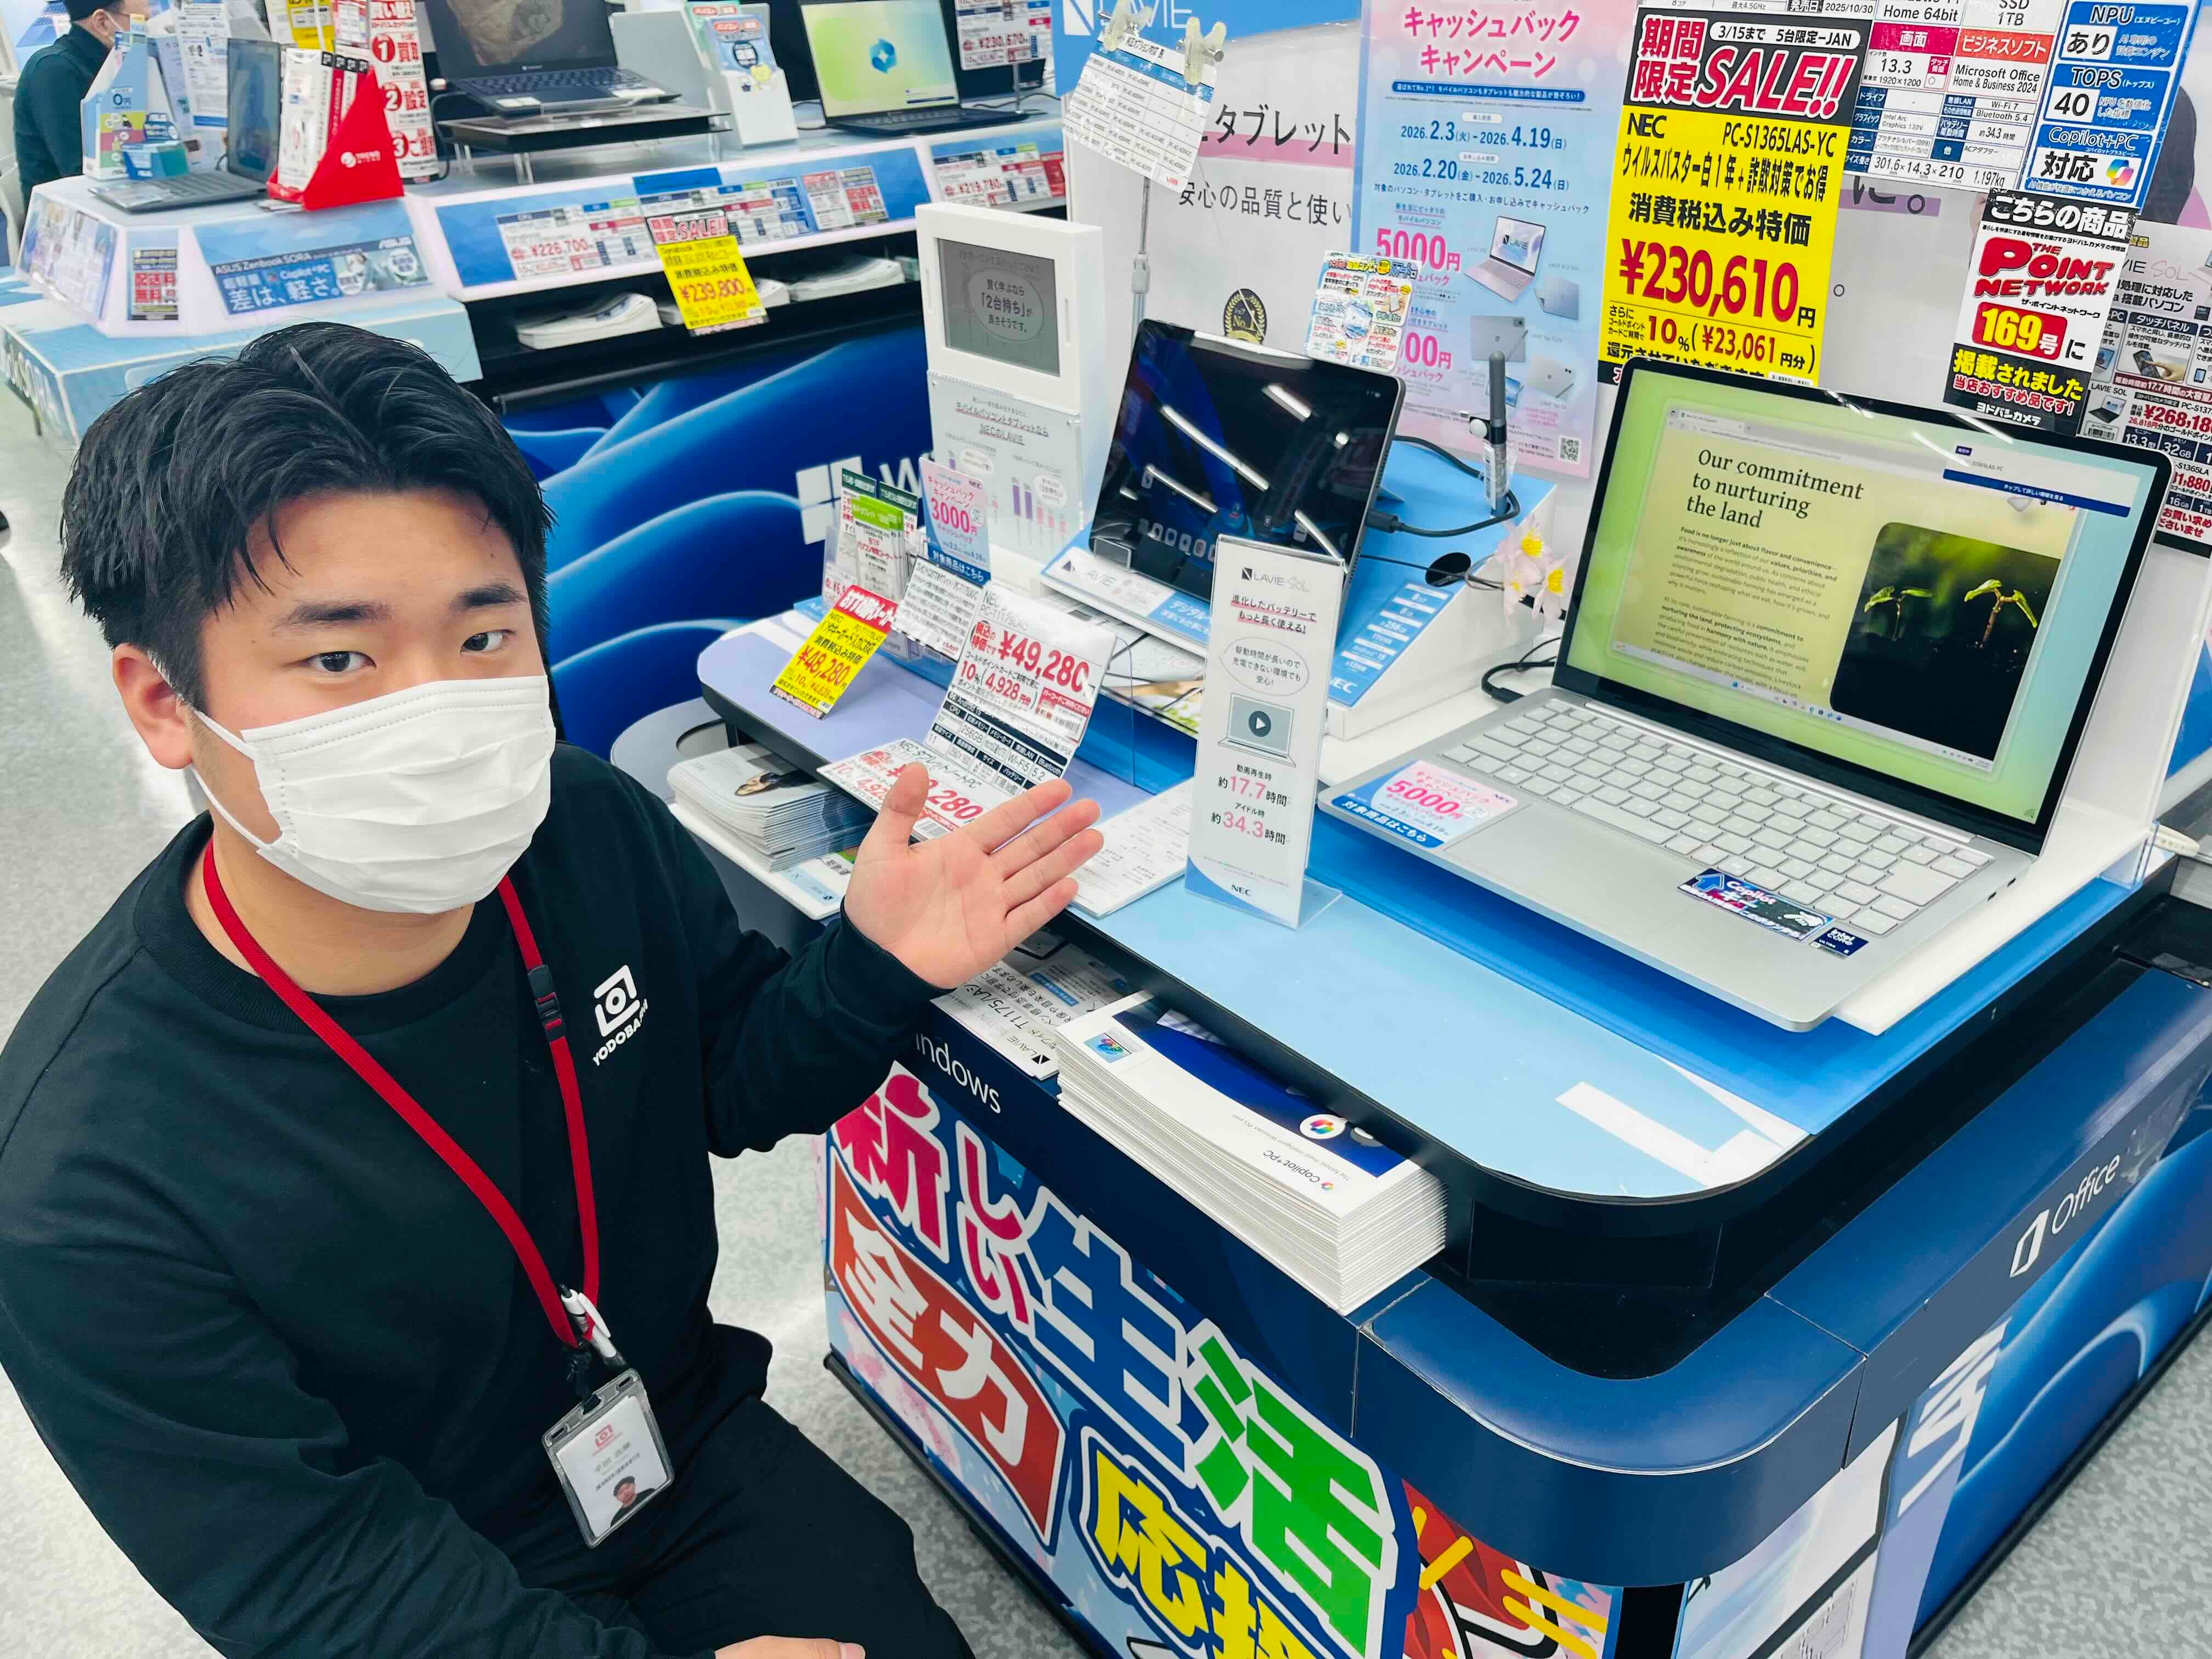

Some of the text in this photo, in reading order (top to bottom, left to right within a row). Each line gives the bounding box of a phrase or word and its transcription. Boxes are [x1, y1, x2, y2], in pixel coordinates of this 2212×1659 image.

[1825, 3, 1874, 14] 2025/10/30
[1883, 4, 1958, 22] Home 64bit
[1998, 12, 2024, 26] 1TB
[2090, 5, 2134, 24] NPU
[1404, 6, 1580, 42] キャッシュバック
[1718, 25, 1766, 41] 3/15まで
[1640, 16, 1707, 59] 期間
[1899, 30, 1928, 49] 画面
[1961, 35, 2047, 58] ビジネスソフト
[2066, 31, 2110, 55] あり
[1420, 44, 1557, 78] キャンペーン
[1881, 58, 1912, 75] 13.3
[1955, 64, 2040, 82] Microsoft Office
[1633, 60, 1696, 104] 限定
[1696, 47, 1858, 119] SALE!!
[1953, 76, 2038, 94] Home & Business 2024
[2072, 67, 2124, 89] TOPS
[1976, 109, 2013, 121] Bluetooth
[2015, 113, 2029, 122] 5.4
[1991, 100, 2012, 110] Wi-Fi
[2054, 92, 2090, 117] 40
[1201, 103, 1351, 155] タブレット
[1882, 120, 1907, 130] Graphics
[1883, 113, 1897, 121] Intel
[1627, 113, 1837, 158] NEC PC-S1365LAS-YC
[1850, 136, 1872, 145] カラー
[2049, 127, 2138, 152] Copilot+PC
[1939, 165, 1965, 179] 210
[2040, 151, 2097, 183] 対応
[1628, 192, 1812, 247] 消費税込み特価
[1991, 195, 2130, 240] こちらの商品
[1978, 236, 2115, 280] POINT
[2032, 242, 2063, 254] THE
[1973, 279, 2109, 298] NETWORK
[1609, 306, 1634, 319] さらに
[2136, 314, 2190, 332] タッチパネル
[1982, 307, 2086, 360] 169号 に
[1953, 349, 2084, 401] 掲載されました
[2090, 383, 2127, 396] LAVIE SOL
[1976, 401, 2041, 426] ヨドバシカメラ
[2144, 404, 2212, 435] ¥268,18
[1698, 449, 1864, 500] Our commitment
[1693, 472, 1812, 520] to nurturing
[1686, 495, 1763, 528] the land
[1677, 545, 1706, 557] awareness
[1680, 527, 1792, 561] Food longer about flavor and
[1254, 573, 1285, 586] LAVIE
[1825, 573, 1837, 582] and
[1231, 594, 1317, 623] 進化したバッテリーで
[1661, 605, 1745, 636] nurturing protecting
[1238, 609, 1307, 634] もっと長く使える!
[1706, 627, 1747, 645] harmony with
[1231, 884, 1252, 898] NEC
[916, 1034, 1001, 1115] indows
[2050, 1154, 2121, 1236] Office
[843, 1205, 1031, 1468] 全力
